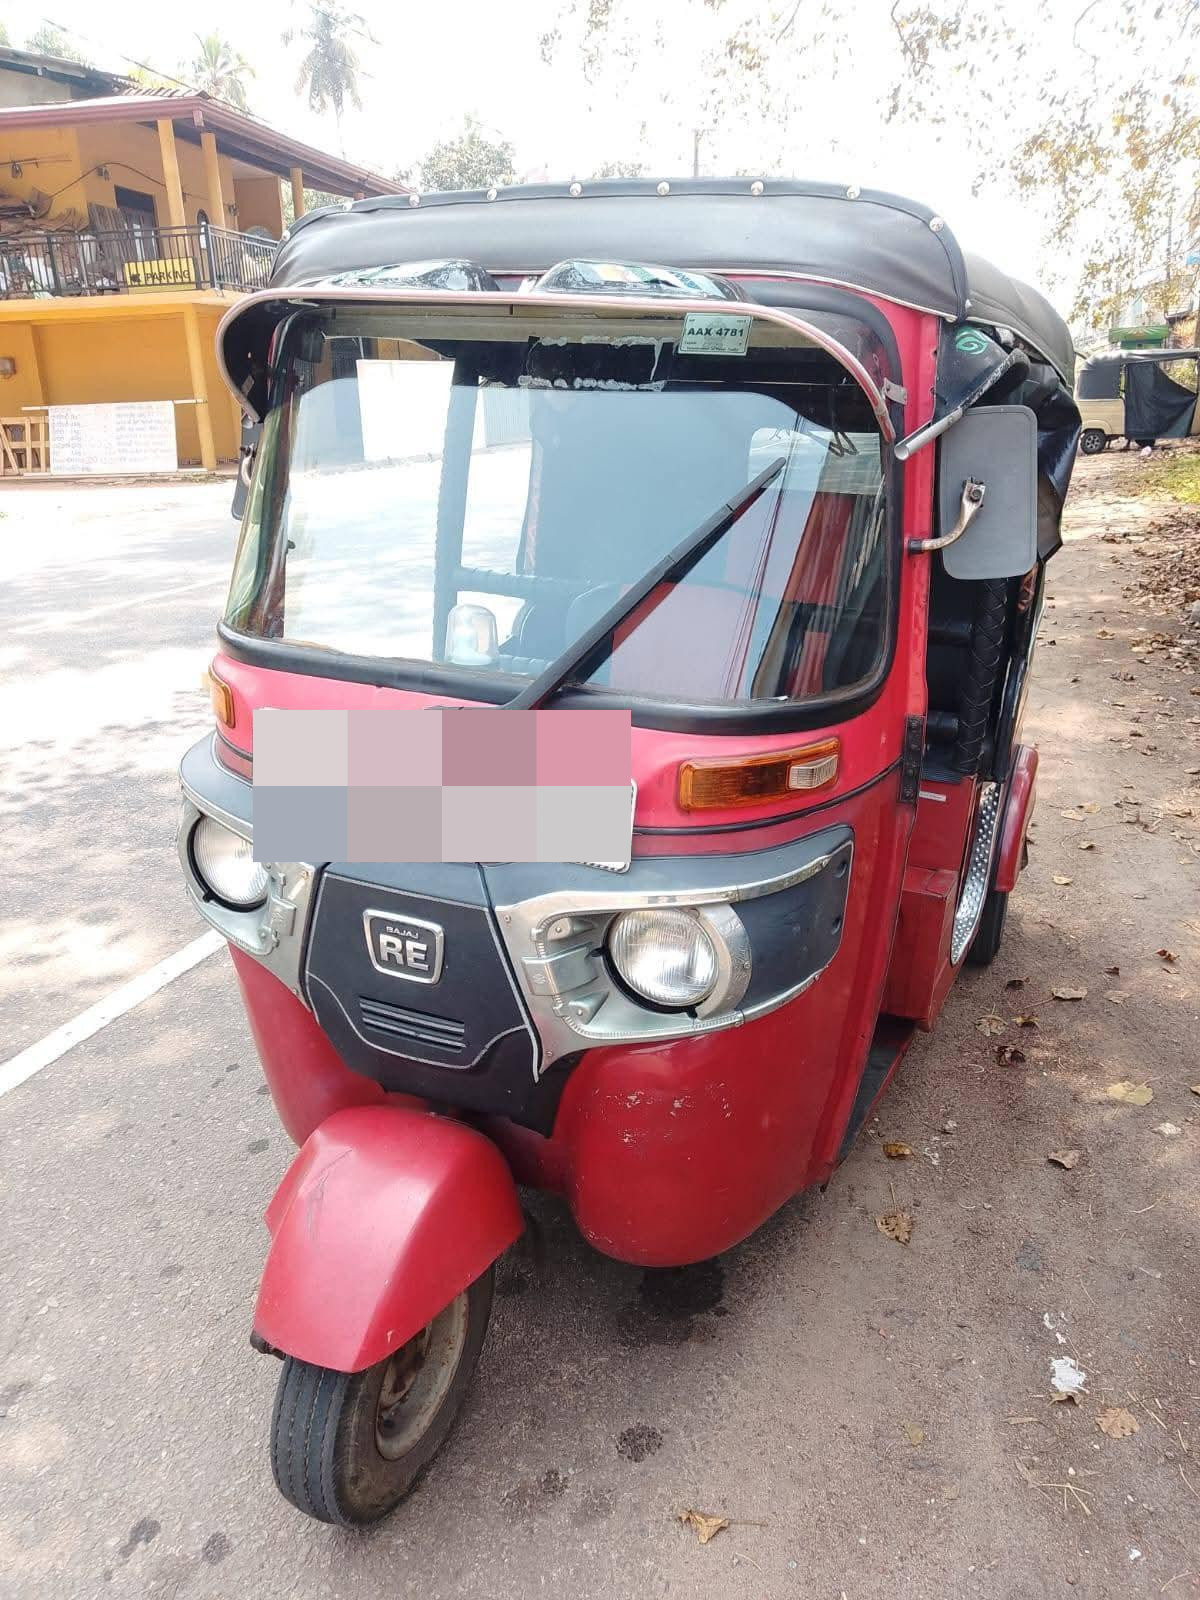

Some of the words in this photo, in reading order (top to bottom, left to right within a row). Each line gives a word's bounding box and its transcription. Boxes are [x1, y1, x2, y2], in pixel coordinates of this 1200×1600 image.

[145, 270, 190, 281] PARKING
[687, 327, 713, 337] AAX
[715, 328, 744, 338] 4781
[386, 926, 419, 939] BAJAJ
[379, 933, 429, 971] RE
